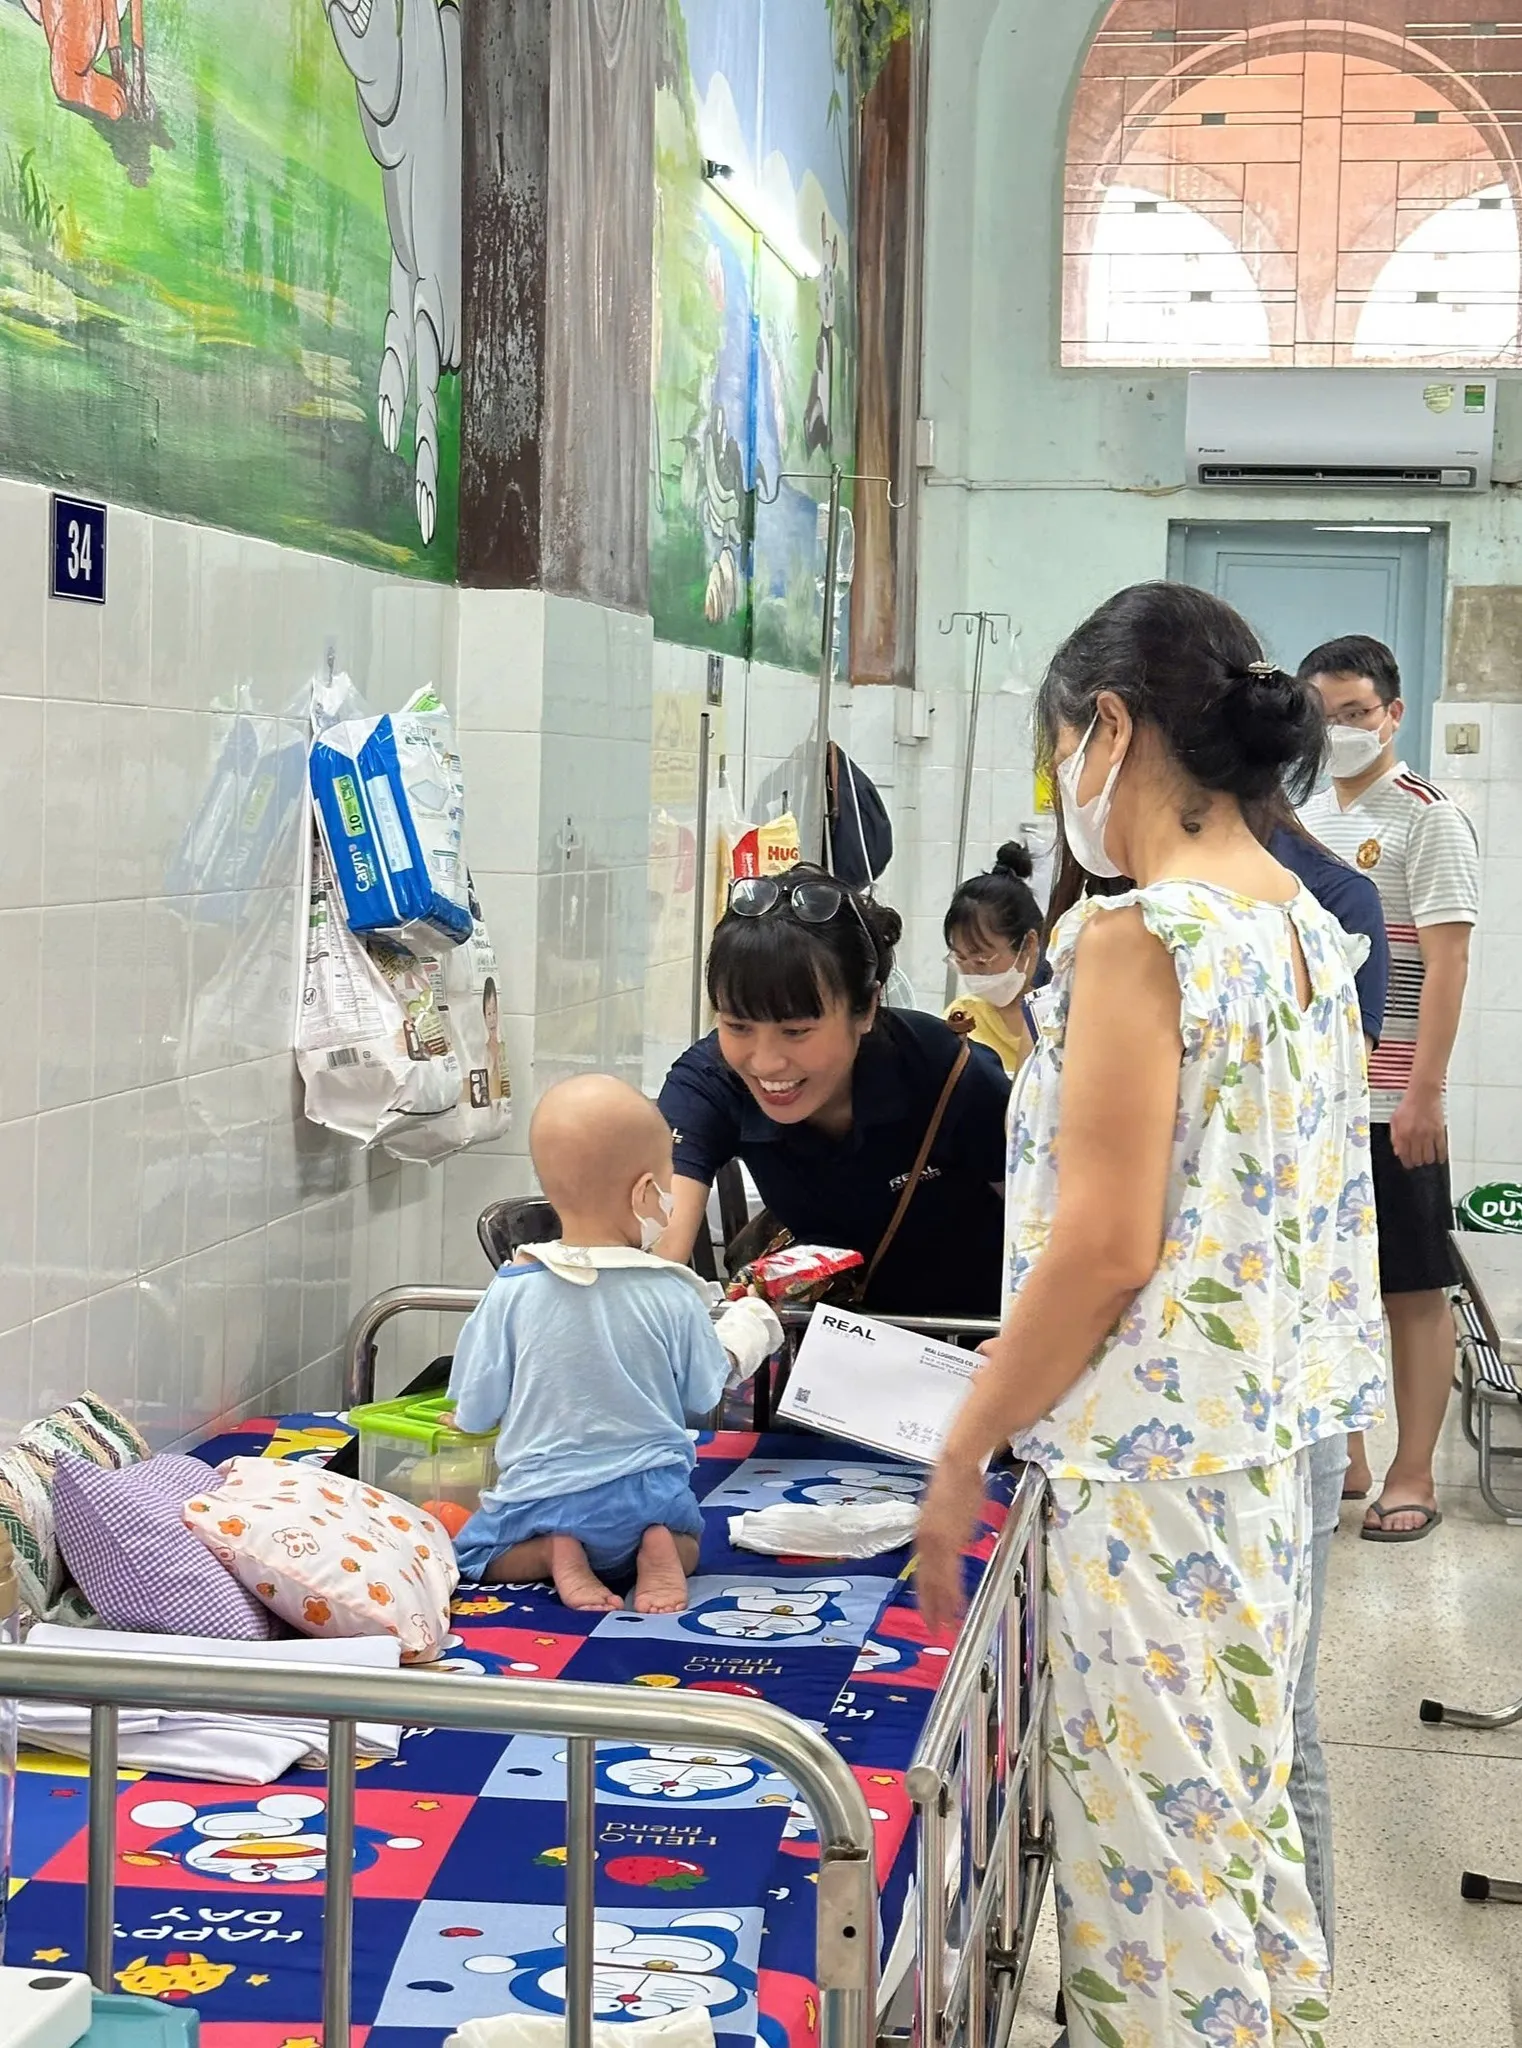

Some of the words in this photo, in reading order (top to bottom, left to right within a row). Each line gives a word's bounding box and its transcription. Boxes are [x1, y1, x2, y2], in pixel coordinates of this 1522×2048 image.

[68, 520, 92, 581] 34
[350, 814, 363, 831] 10
[768, 846, 799, 861] HUG
[351, 851, 370, 892] Caryn
[889, 1165, 939, 1188] REL
[822, 1315, 876, 1342] REAL
[456, 1583, 557, 1595] HAPP
[683, 1663, 783, 1675] HELLO
[690, 1656, 773, 1666] friend
[605, 1822, 703, 1836] friend
[599, 1832, 717, 1846] HELLO
[150, 1906, 283, 1925] DAY
